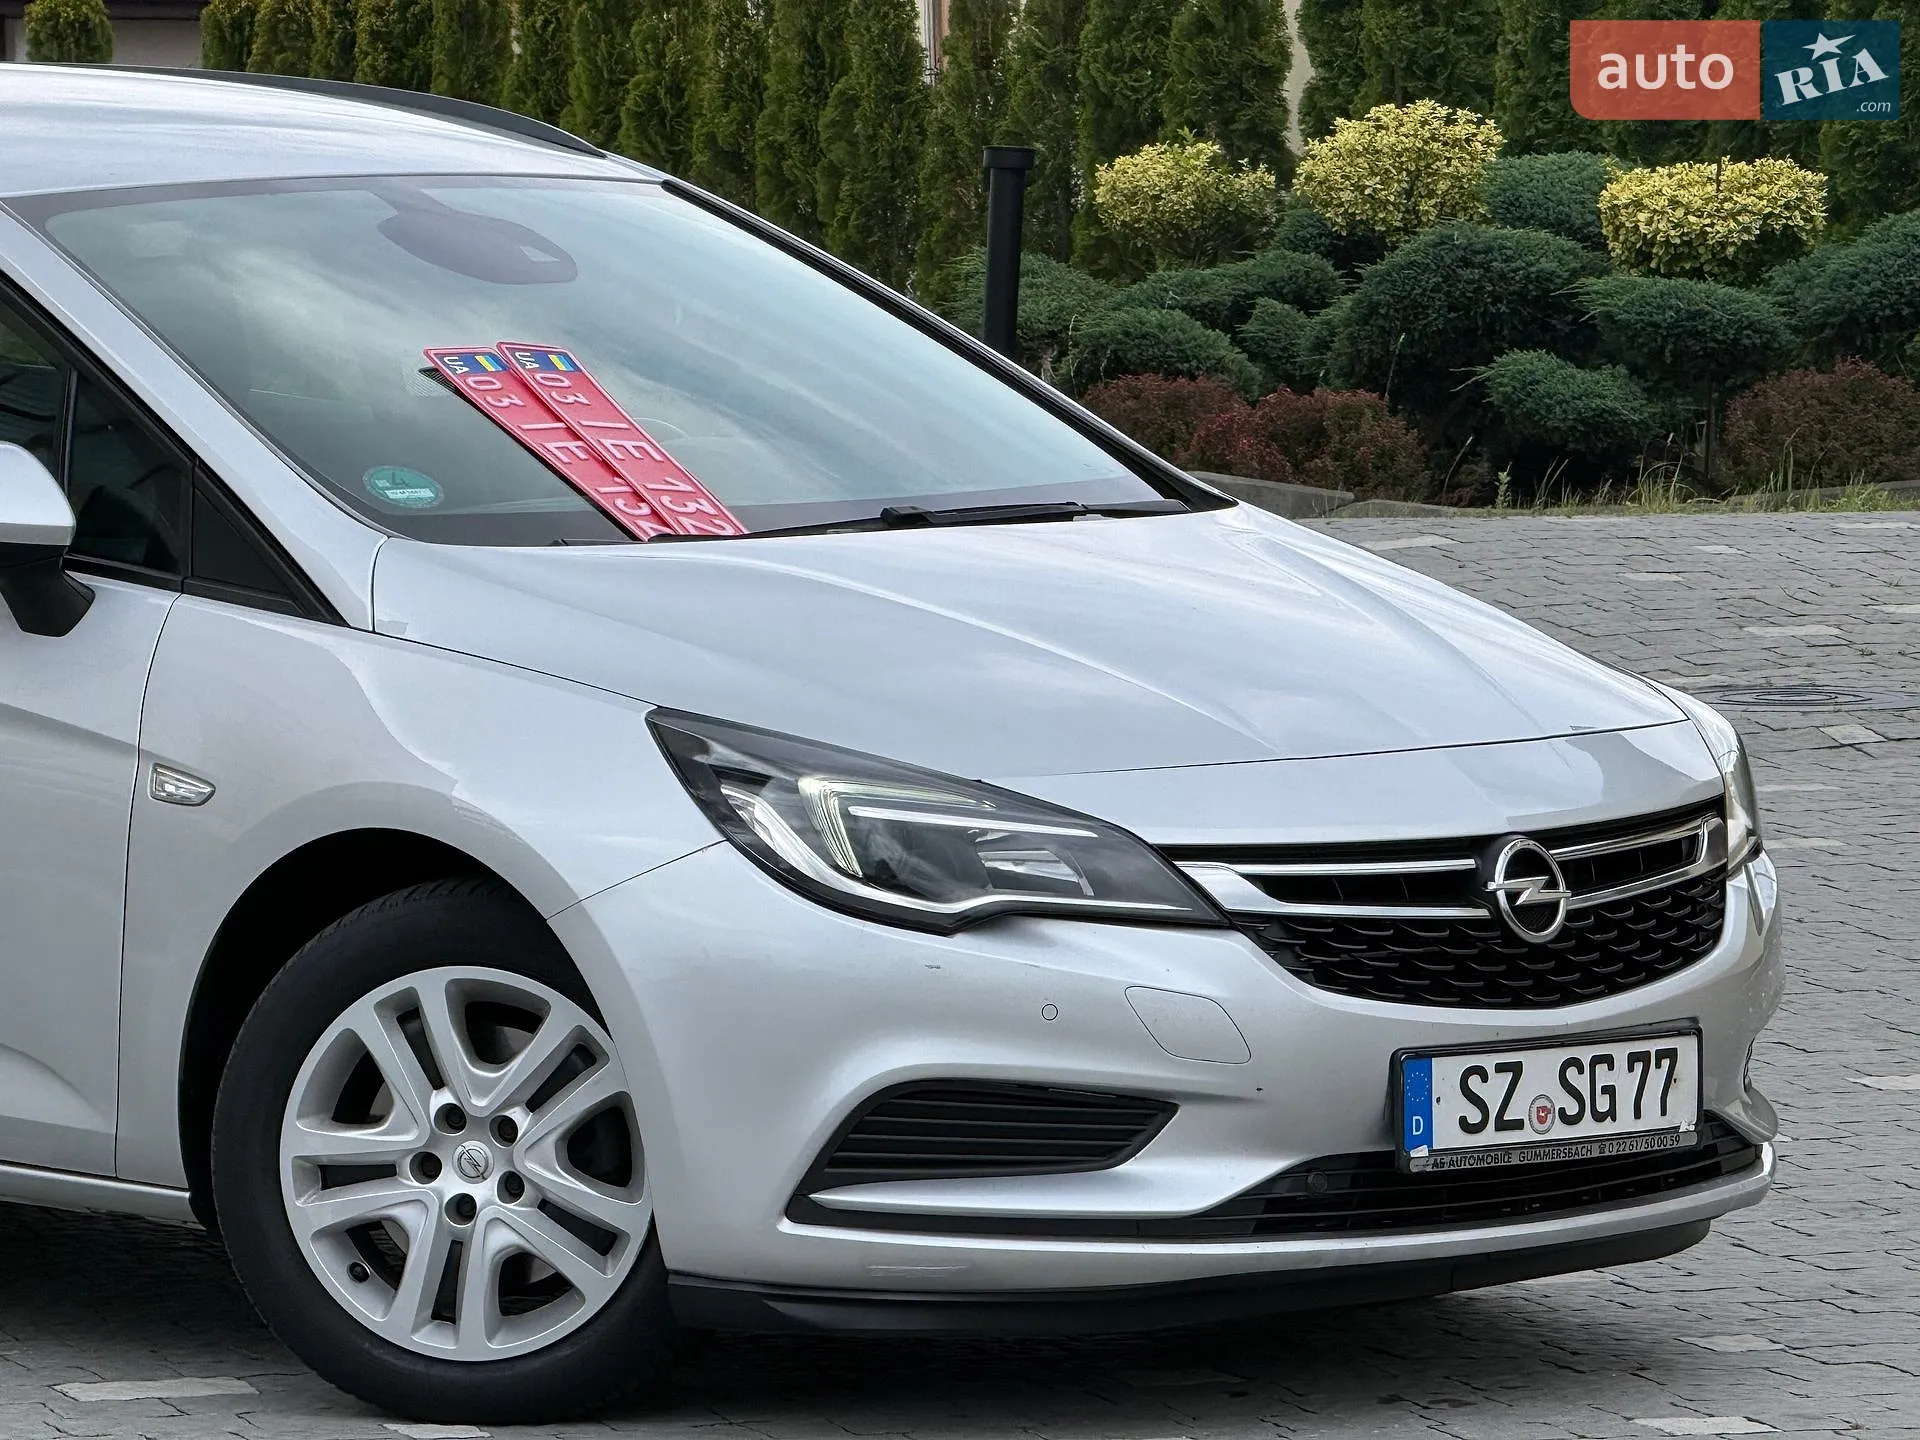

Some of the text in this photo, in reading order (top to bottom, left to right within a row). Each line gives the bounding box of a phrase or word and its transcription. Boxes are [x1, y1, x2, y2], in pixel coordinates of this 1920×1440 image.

[443, 356, 470, 374] UA
[514, 351, 539, 369] UA
[465, 376, 526, 408] 03
[533, 373, 592, 406] 03
[1458, 1060, 1525, 1135] SZ
[1412, 1115, 1424, 1136] D
[1448, 1151, 1512, 1168] AUTOMOBILE
[1518, 1145, 1593, 1163] GUMMERSBACH
